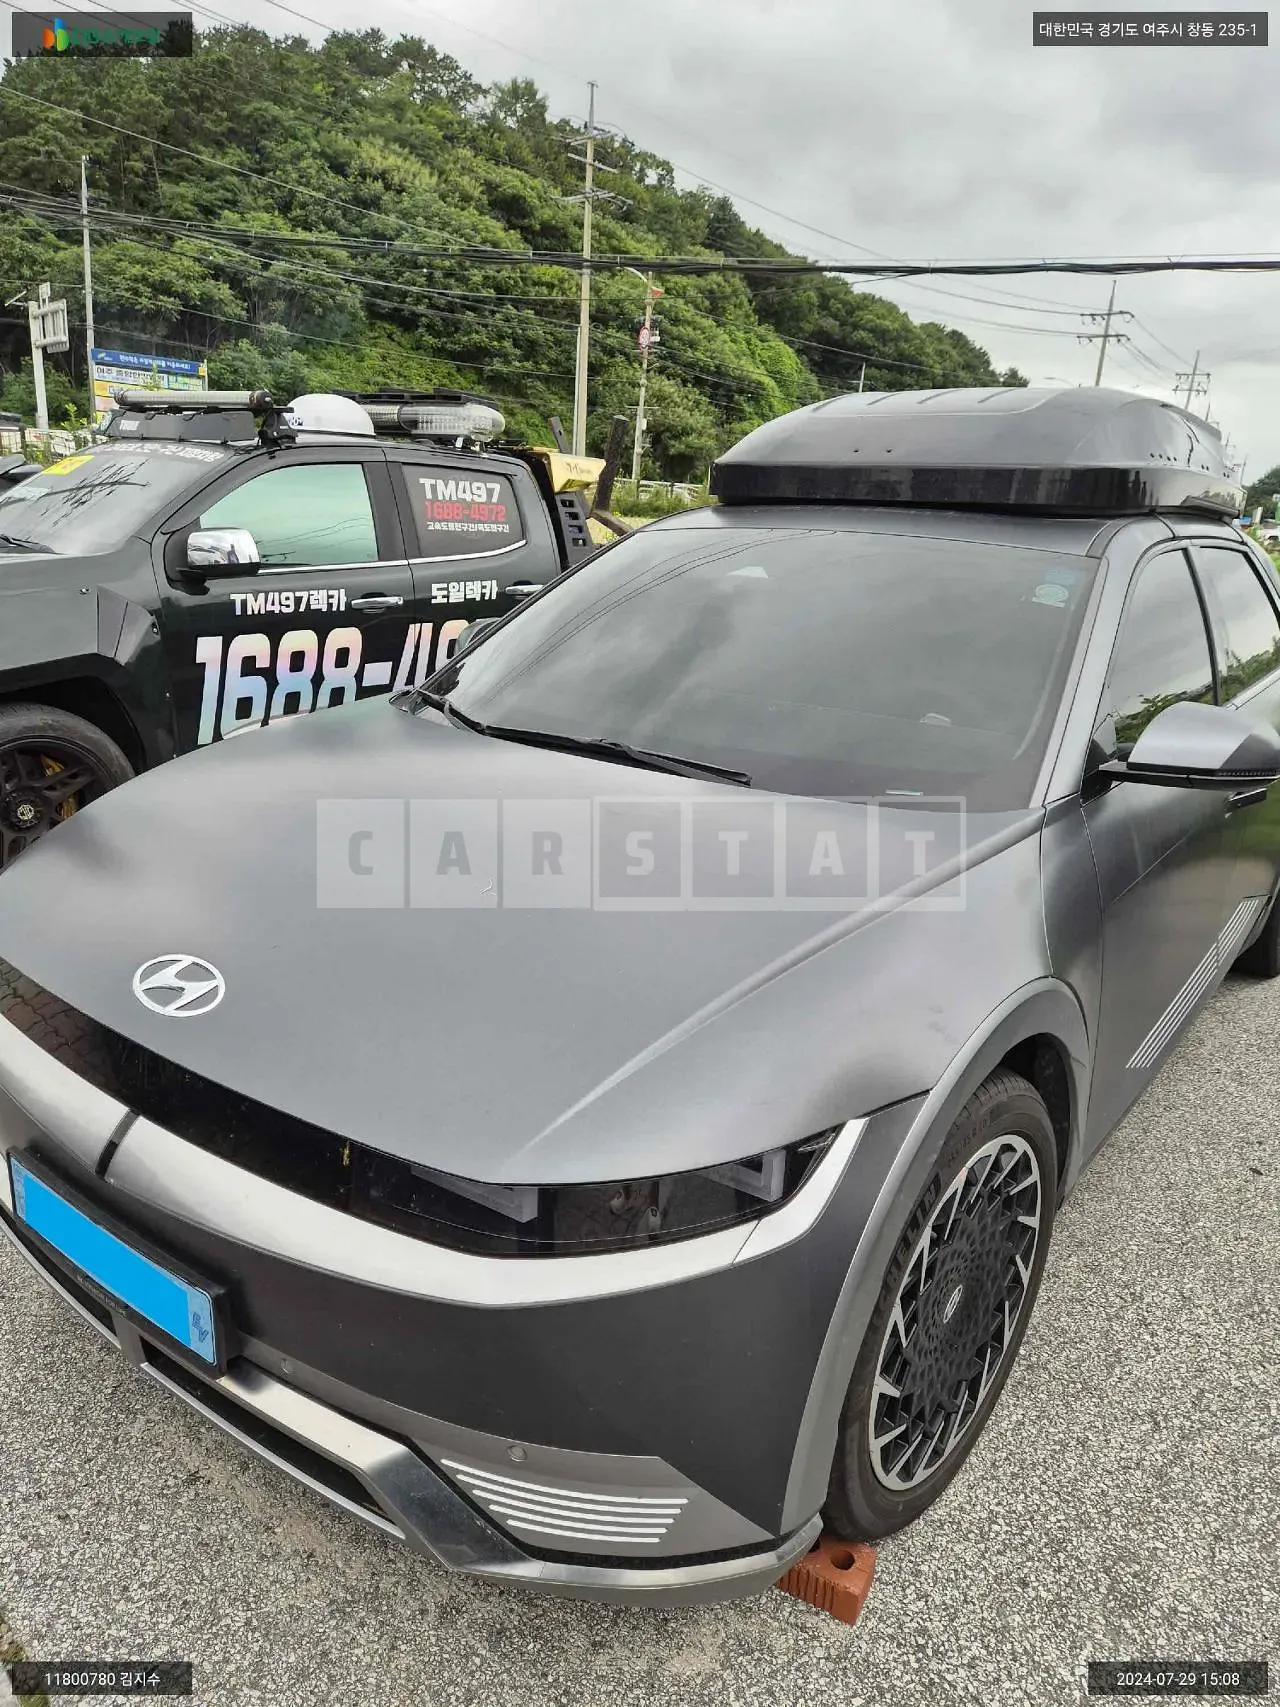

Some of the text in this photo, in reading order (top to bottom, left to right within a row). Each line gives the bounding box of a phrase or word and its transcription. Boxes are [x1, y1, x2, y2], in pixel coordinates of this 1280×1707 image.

[418, 477, 501, 503] TM497
[425, 501, 507, 522] 1688-4972
[229, 588, 347, 616] TM497렉카
[431, 579, 499, 604] 도일렉카
